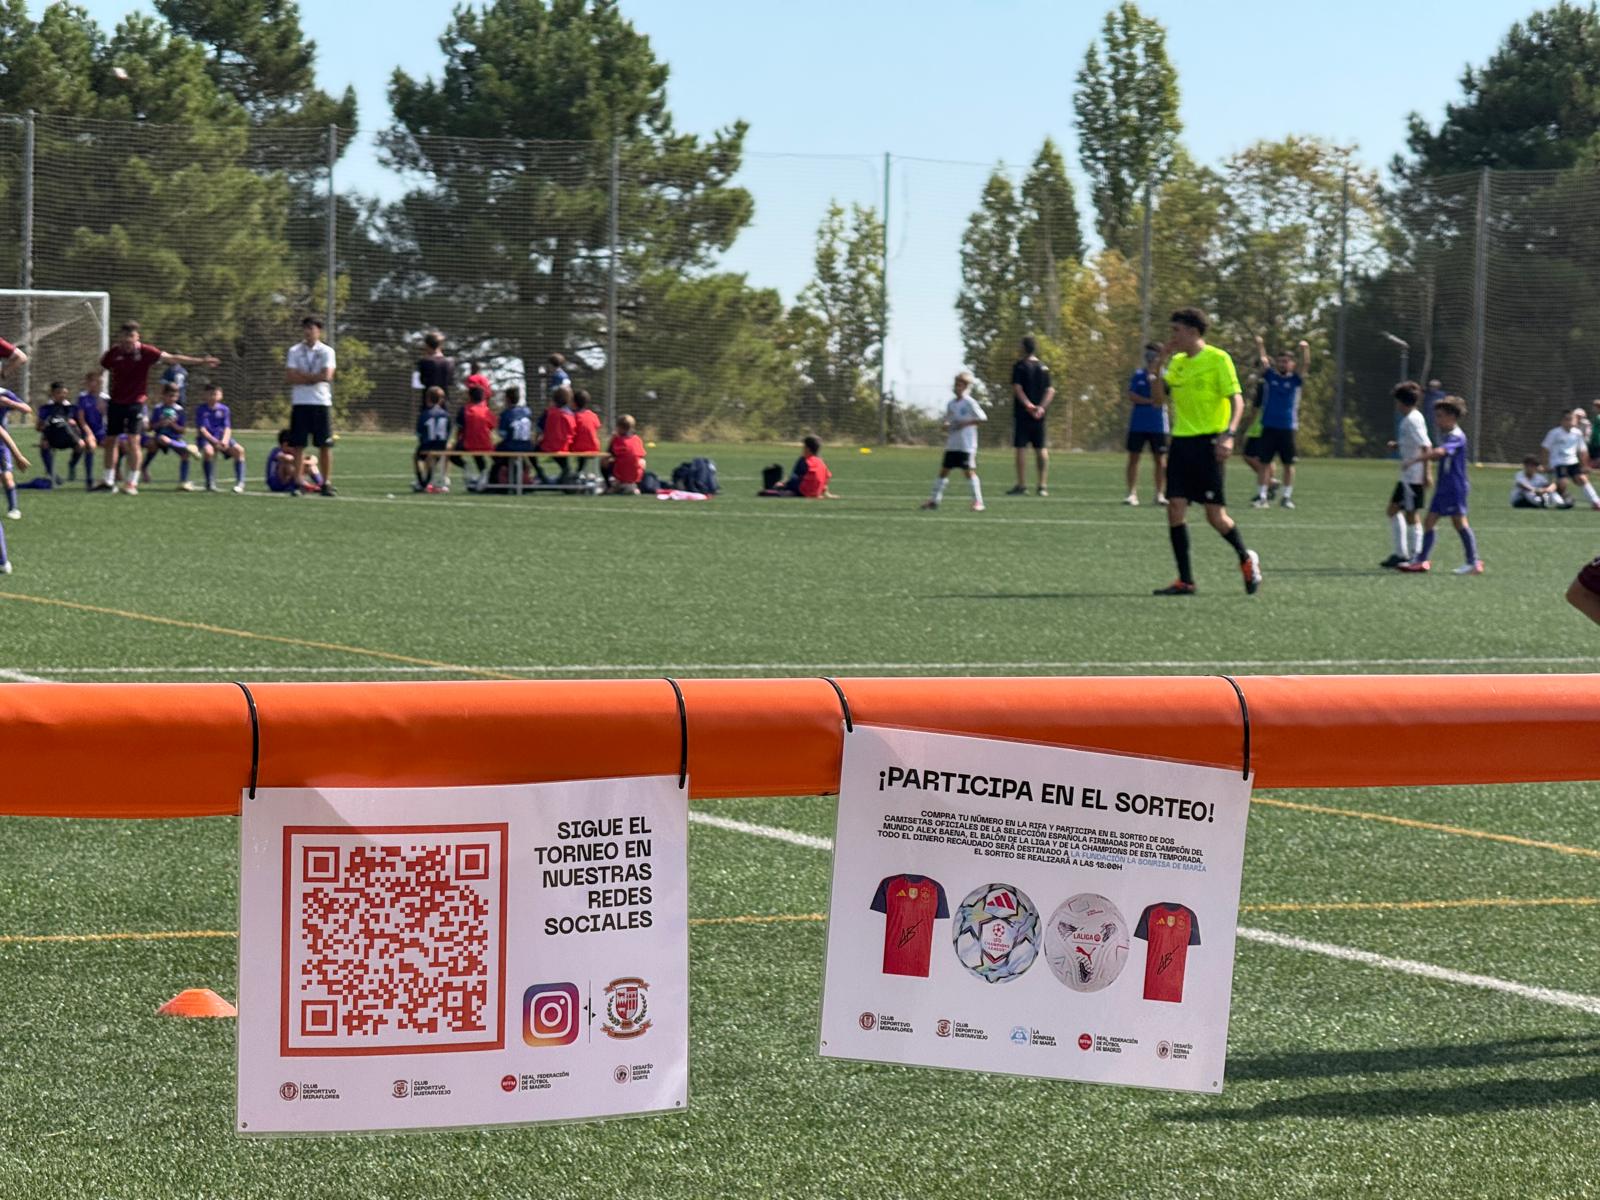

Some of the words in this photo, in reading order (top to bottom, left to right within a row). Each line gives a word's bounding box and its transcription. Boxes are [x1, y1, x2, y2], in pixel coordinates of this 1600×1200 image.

[424, 418, 448, 440] 14
[878, 766, 1034, 802] ¡PARTICIPA
[1041, 783, 1074, 806] EN
[1082, 788, 1108, 810] EL
[1115, 791, 1214, 822] SORTEO!
[557, 818, 623, 839] SIGUE
[630, 816, 652, 834] EL
[884, 815, 932, 826] CAMISETAS
[935, 819, 978, 830] OFICIALES
[1004, 827, 1047, 838] SELECCIÓN
[1049, 832, 1087, 843] ESPAÑOLA
[1089, 837, 1128, 846] FIRMADAS
[1156, 844, 1190, 855] CAMPEÓN
[921, 810, 956, 820] COMPRA
[958, 814, 969, 822] TU
[971, 814, 1003, 825] NÚMERO
[1029, 822, 1047, 830] RIFA
[1056, 826, 1096, 835] PARTICIPA
[1120, 832, 1148, 841] SORTEO
[534, 842, 618, 864] TORNEO
[625, 839, 651, 858] EN
[878, 830, 900, 839] TODO
[913, 834, 944, 843] DINERO
[946, 838, 994, 848] RECAUDADO
[995, 841, 1015, 850] SERÁ
[1017, 845, 1062, 856] DESTINADO
[1082, 852, 1125, 864] FUNDACIÓN
[1138, 859, 1171, 868] SONRISA
[1183, 863, 1207, 872] MARÍA
[883, 823, 914, 831] MUNDO
[916, 826, 937, 834] ALEX
[939, 828, 968, 838] BAENA,
[981, 832, 1006, 841] BALÓN
[1031, 838, 1050, 847] LIGA
[1071, 842, 1080, 850] LA
[1082, 844, 1127, 855] CHAMPIONS
[1140, 851, 1157, 859] ESTA
[984, 850, 1014, 858] SORTEO
[1028, 854, 1070, 865] REALIZARÁ
[1080, 860, 1094, 868] LAS
[543, 863, 652, 888] NUESTRAS
[588, 886, 652, 909] REDES
[544, 910, 652, 935] SOCIALES
[1073, 933, 1093, 941] LALIGA
[537, 1071, 569, 1079] FEDERACIÓN
